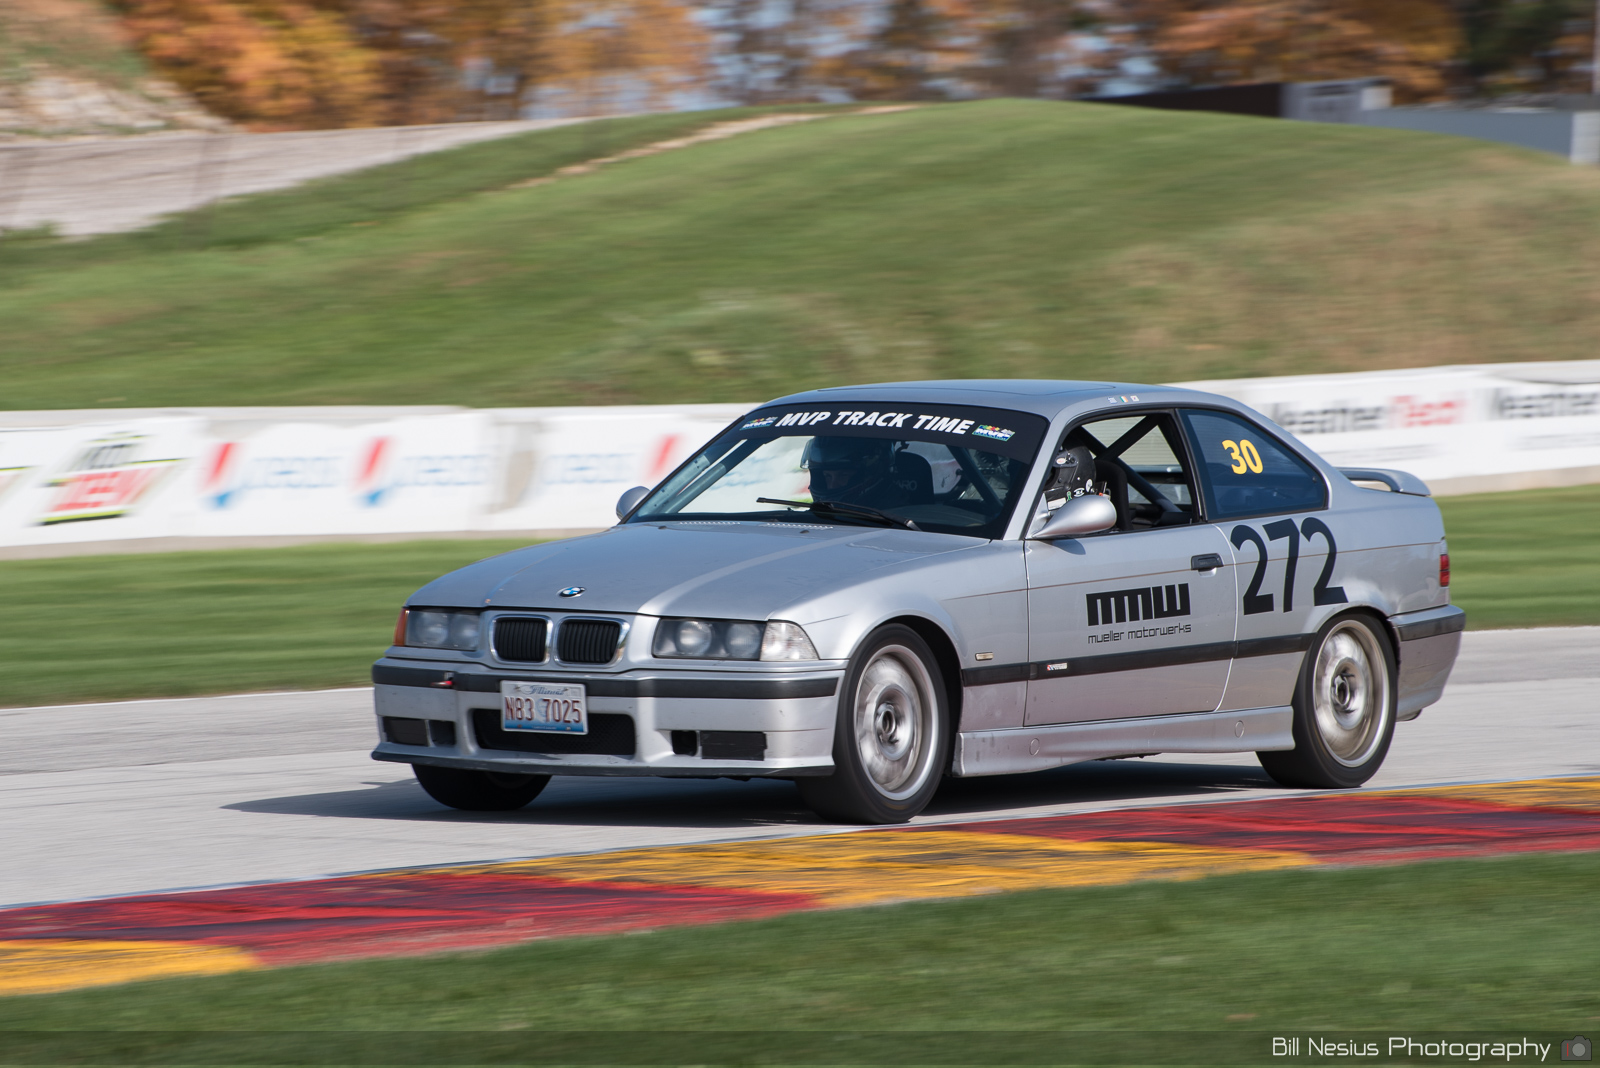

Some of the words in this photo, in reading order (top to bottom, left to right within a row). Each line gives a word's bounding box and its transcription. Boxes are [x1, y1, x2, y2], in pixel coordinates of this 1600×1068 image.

[775, 411, 831, 427] MVP
[832, 411, 913, 428] TRACK
[913, 414, 975, 435] TIME
[1222, 439, 1263, 474] 30
[1230, 517, 1349, 615] 272
[1088, 630, 1124, 644] mueller
[1128, 622, 1191, 640] motorwerks
[504, 697, 535, 721] N83
[542, 698, 583, 723] 7025
